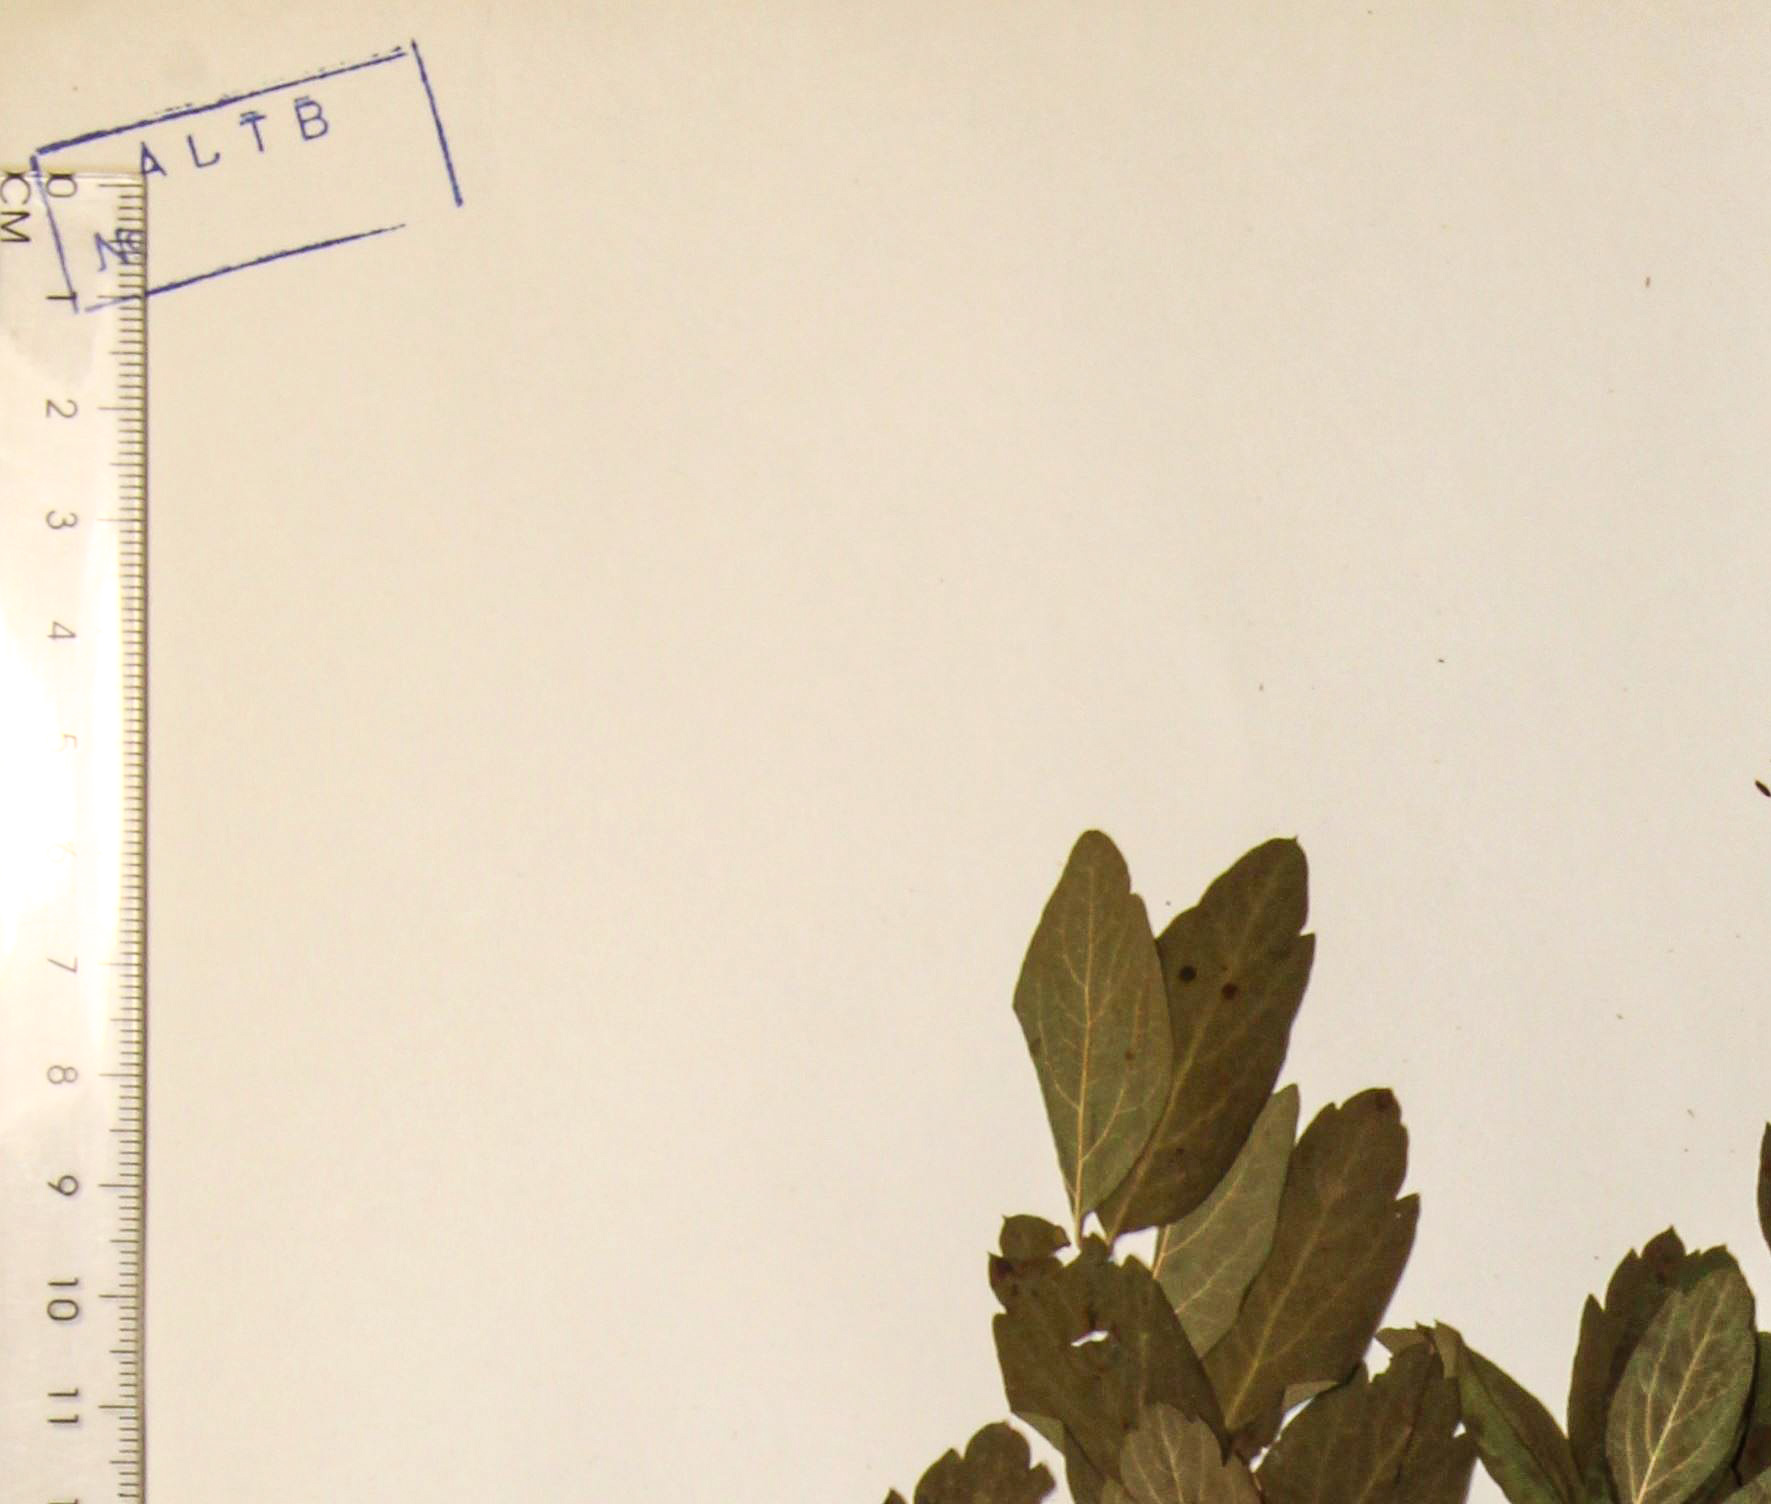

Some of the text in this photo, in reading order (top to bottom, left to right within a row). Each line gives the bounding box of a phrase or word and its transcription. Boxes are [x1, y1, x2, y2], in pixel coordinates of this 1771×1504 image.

[139, 95, 329, 177] ALTB
[0, 172, 31, 242] CM
[46, 291, 77, 301] 1
[46, 399, 78, 419] 2
[45, 510, 79, 530] 3
[48, 621, 77, 640] 4
[48, 959, 77, 973] 7
[47, 1065, 79, 1085] 8
[47, 1174, 81, 1198] 9
[46, 1277, 81, 1324] 10
[47, 1387, 81, 1428] 11
